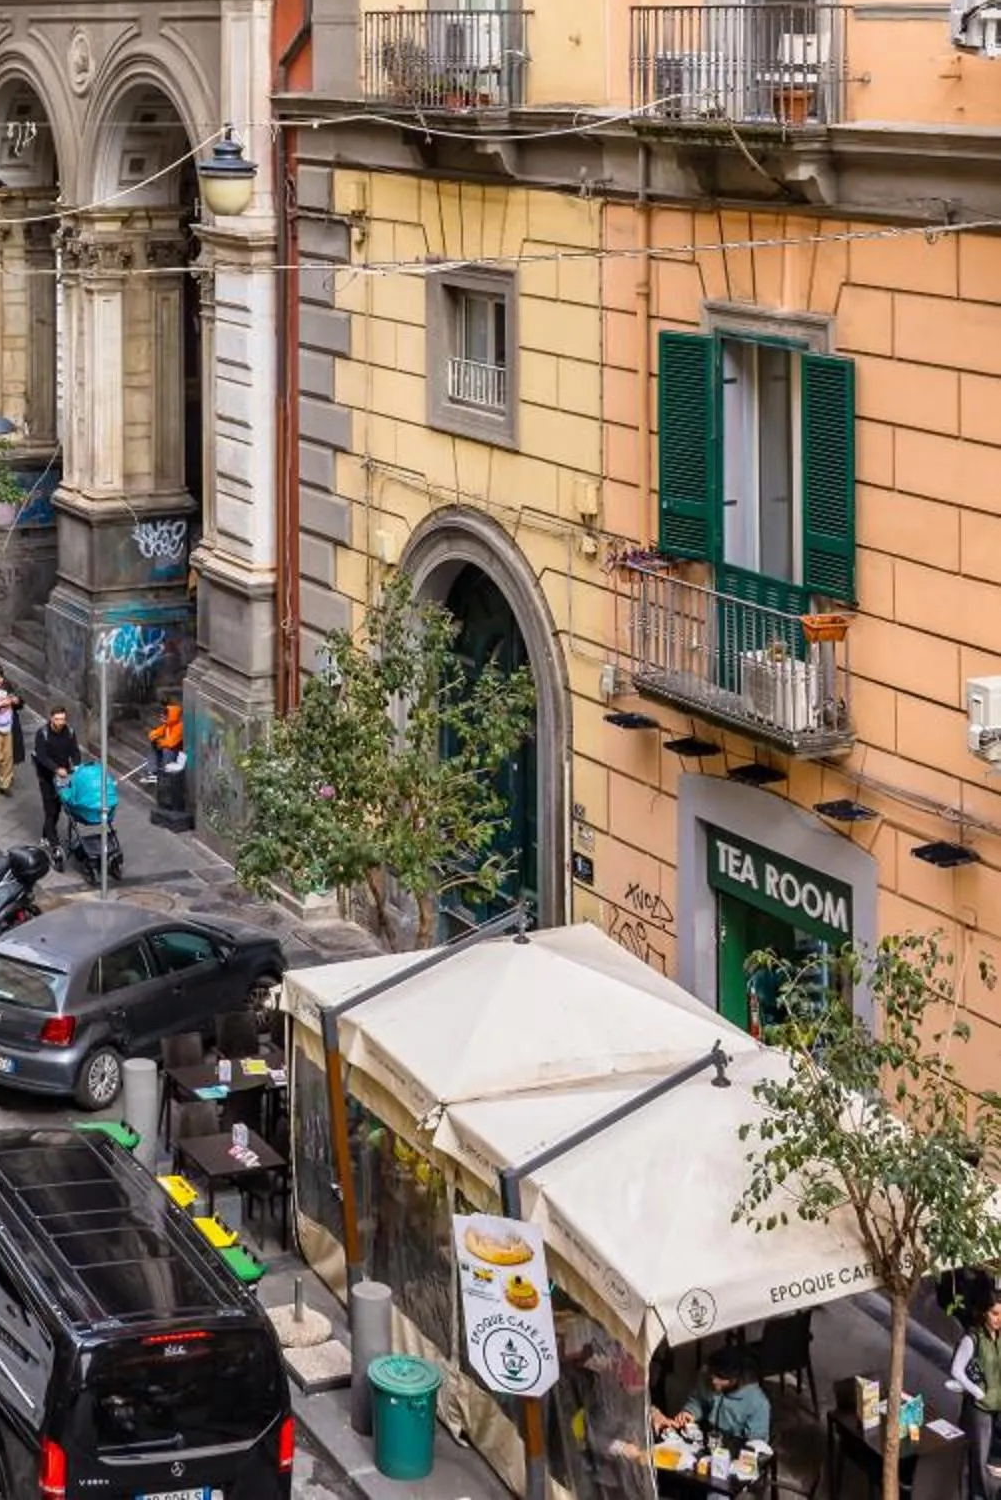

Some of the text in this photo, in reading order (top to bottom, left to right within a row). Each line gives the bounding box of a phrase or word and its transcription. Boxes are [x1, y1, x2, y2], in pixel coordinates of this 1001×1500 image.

[715, 839, 849, 933] TEA ROOM
[770, 1271, 836, 1303] EPOQUE
[470, 1313, 507, 1346] EPOQUE
